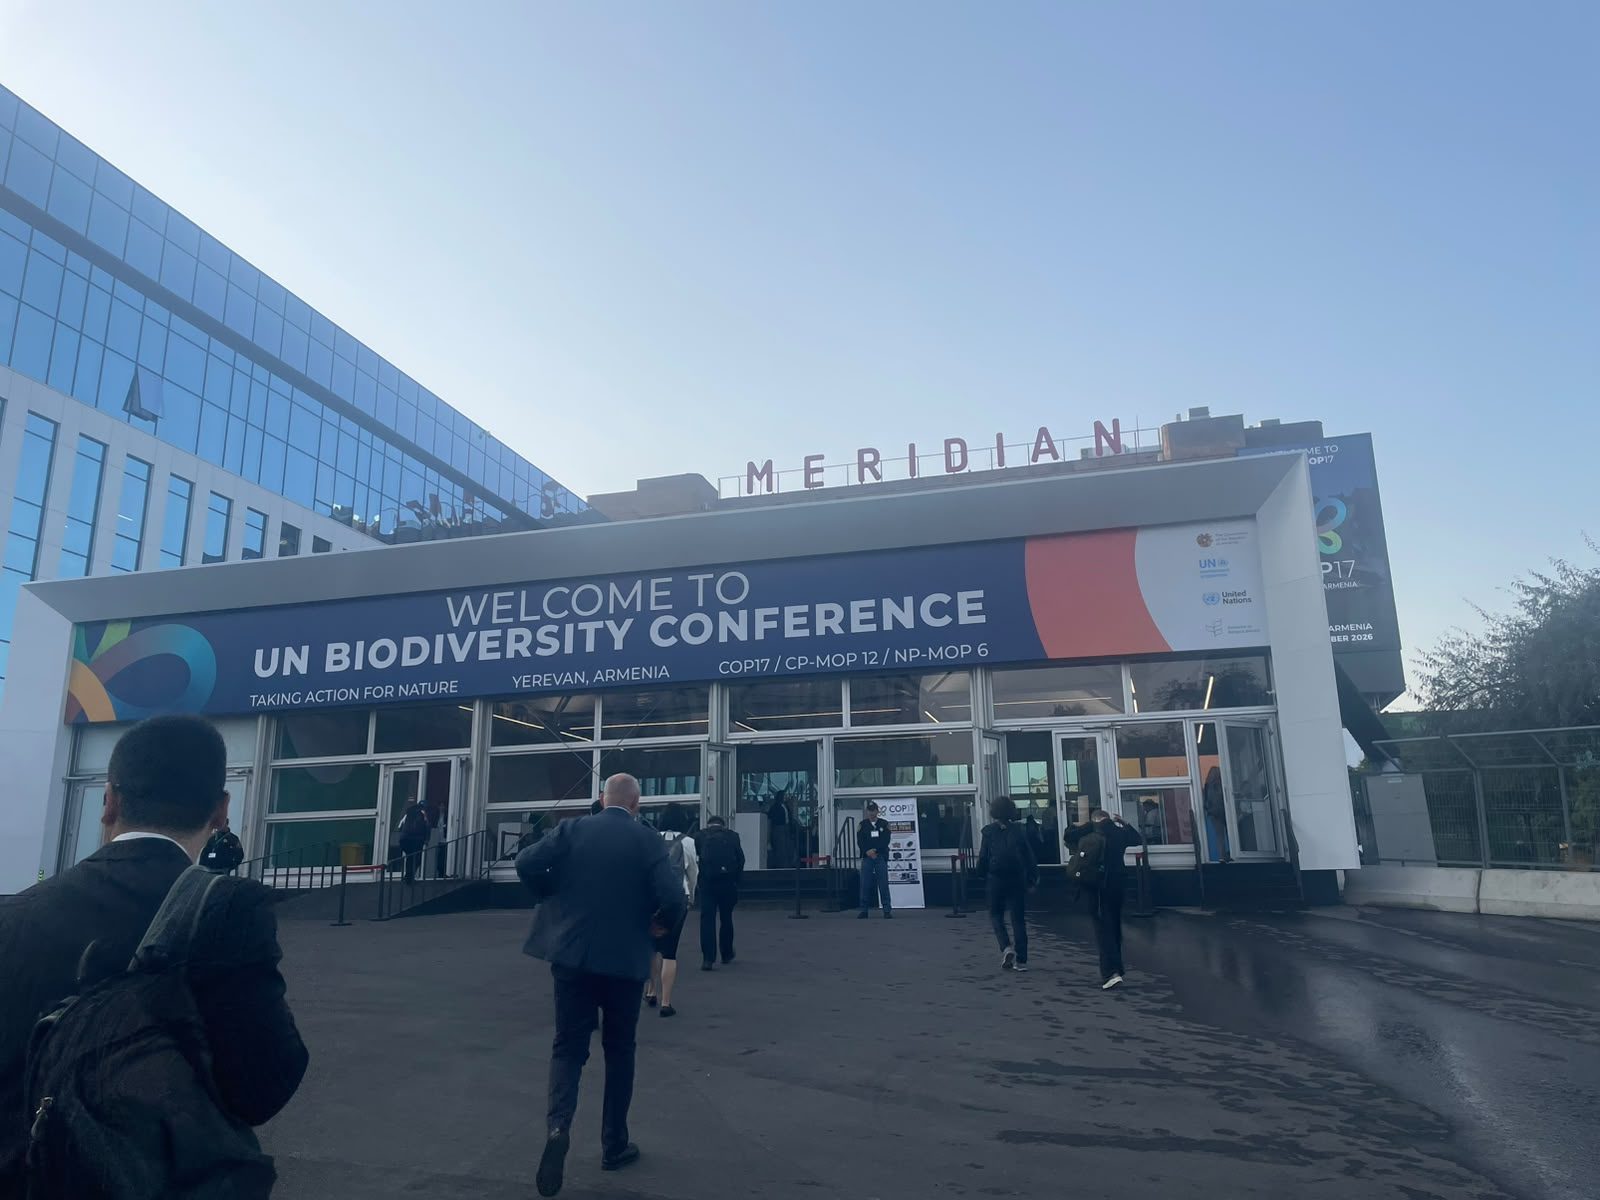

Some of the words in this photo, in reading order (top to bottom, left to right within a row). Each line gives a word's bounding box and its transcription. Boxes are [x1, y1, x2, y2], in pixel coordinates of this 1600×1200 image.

[747, 418, 1122, 494] MERIDIAN
[1324, 444, 1339, 453] TO
[1308, 455, 1334, 465] OP17
[1199, 559, 1216, 569] UN
[1320, 560, 1355, 579] P17
[446, 577, 673, 627] WELCOME
[688, 571, 750, 607] TO
[1221, 589, 1247, 598] United
[253, 645, 310, 678] UN
[325, 617, 634, 673] BIODIVERSITY
[650, 590, 986, 647] CONFERENCE
[1329, 623, 1373, 632] ARMENIA
[1351, 634, 1373, 642] 2026
[718, 658, 771, 675] COP17
[774, 655, 782, 673] /
[785, 653, 858, 671] CP-MOP
[862, 651, 879, 666] 12
[883, 647, 890, 666] /
[895, 644, 972, 664] NP-MOP
[977, 643, 989, 658] 6
[512, 671, 589, 689] YEREVAN,
[593, 665, 670, 684] ARMENIA
[250, 692, 302, 707] TAKING
[304, 687, 360, 704] ACTION
[364, 685, 394, 699] FOR
[398, 680, 459, 697] NATURE
